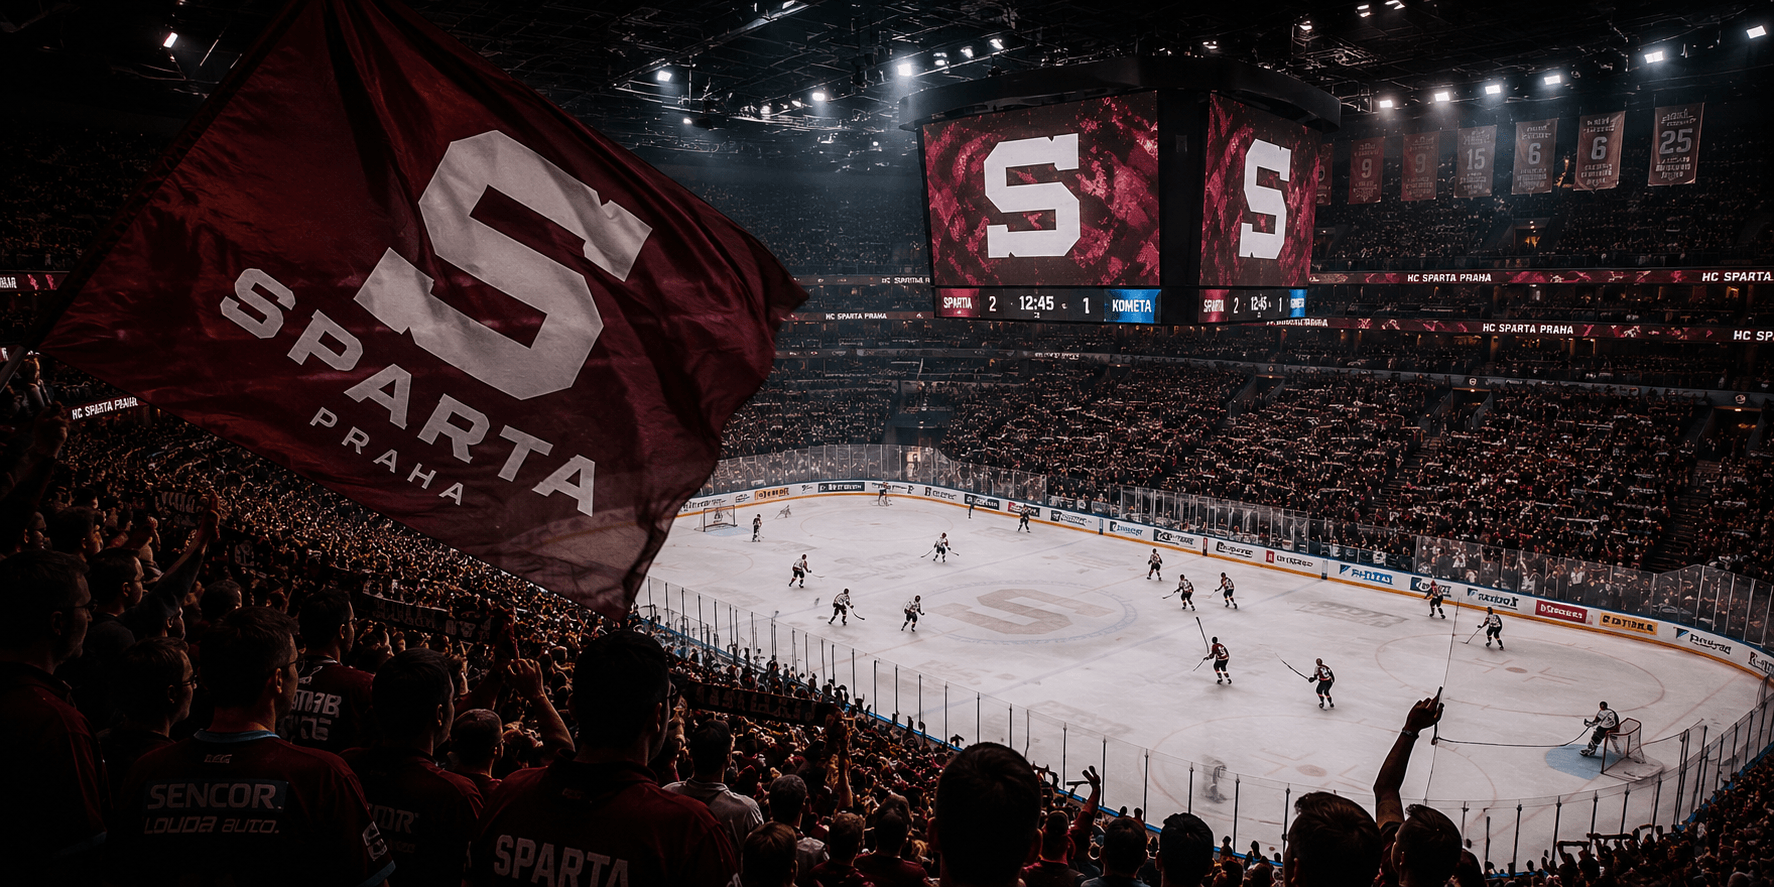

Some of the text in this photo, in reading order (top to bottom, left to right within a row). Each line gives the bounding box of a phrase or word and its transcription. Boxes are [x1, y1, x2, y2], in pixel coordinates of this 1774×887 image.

[1591, 136, 1608, 160] 6
[1659, 128, 1693, 154] 25
[1415, 153, 1426, 173] 9
[1466, 148, 1486, 170] 15
[1528, 142, 1541, 165] 6
[1361, 158, 1373, 178] 9
[984, 133, 1081, 258] S
[1239, 138, 1291, 259] S
[353, 130, 652, 400] S
[1701, 271, 1772, 281] HC SPARTA
[1407, 273, 1492, 282] HC SPARTA PRAHA
[988, 296, 997, 312] 2
[1019, 295, 1054, 311] 12:45
[1083, 297, 1090, 314] 1
[1112, 299, 1152, 313] KOMETA
[1233, 297, 1239, 313] 2
[1278, 296, 1282, 312] 1
[1482, 323, 1574, 334] HC SPARTA PRAHA
[1733, 330, 1774, 341] HC SP
[220, 268, 596, 517] SPARTA
[71, 407, 83, 420] HC
[310, 406, 465, 505] PRAHA
[493, 834, 629, 887] SPARTA
